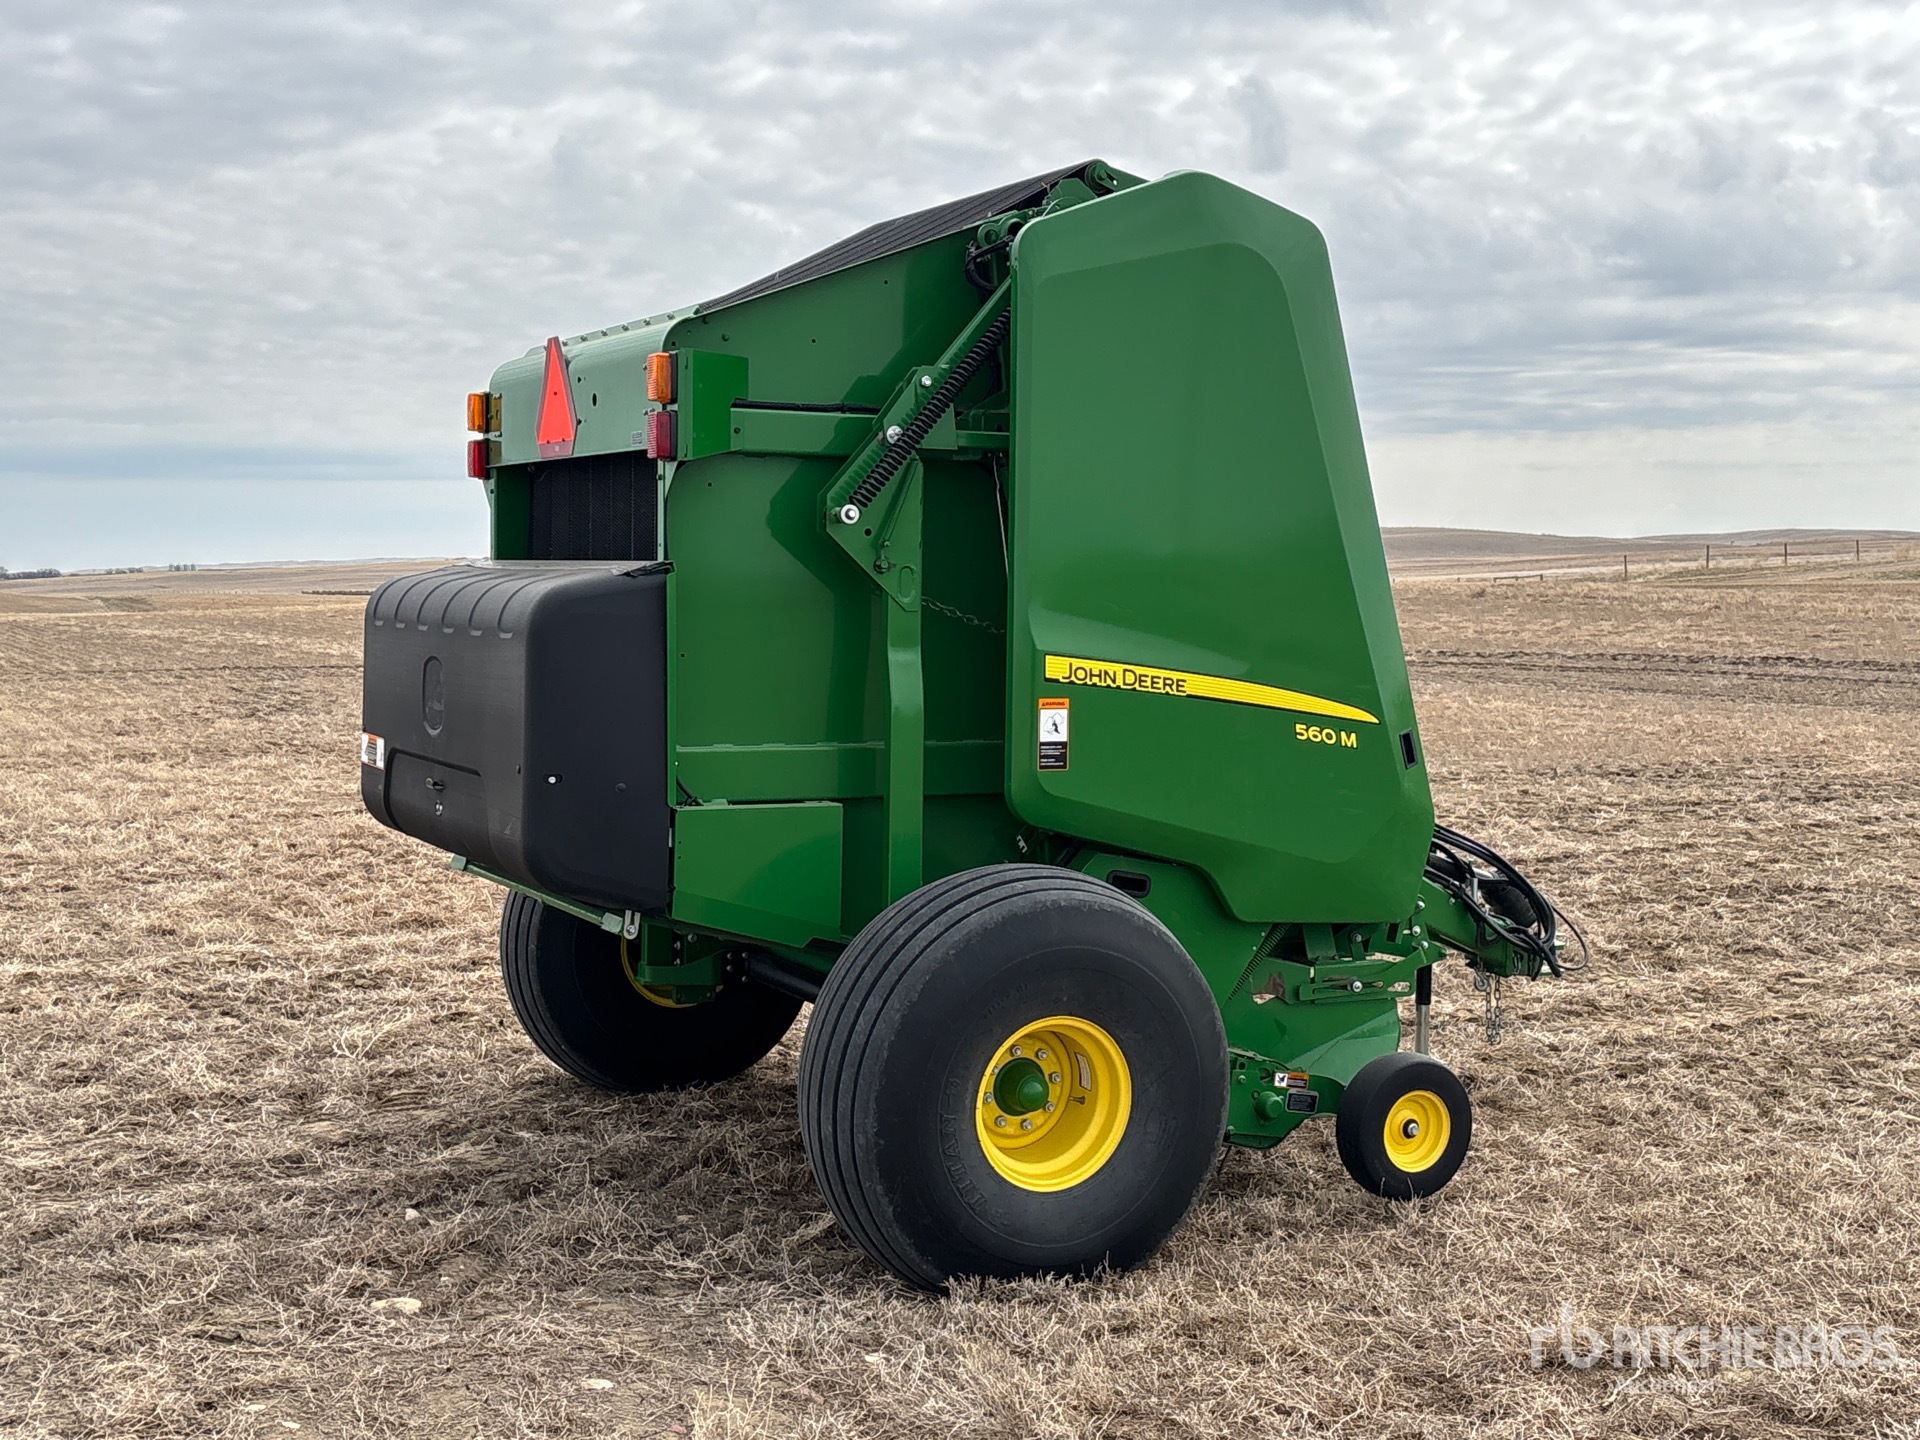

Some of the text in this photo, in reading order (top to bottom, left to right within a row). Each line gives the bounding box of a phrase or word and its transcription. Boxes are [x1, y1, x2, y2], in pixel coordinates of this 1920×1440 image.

[1061, 662, 1187, 693] JOHN DEERE
[1296, 723, 1359, 749] 560 M
[940, 1112, 988, 1214] TITAN
